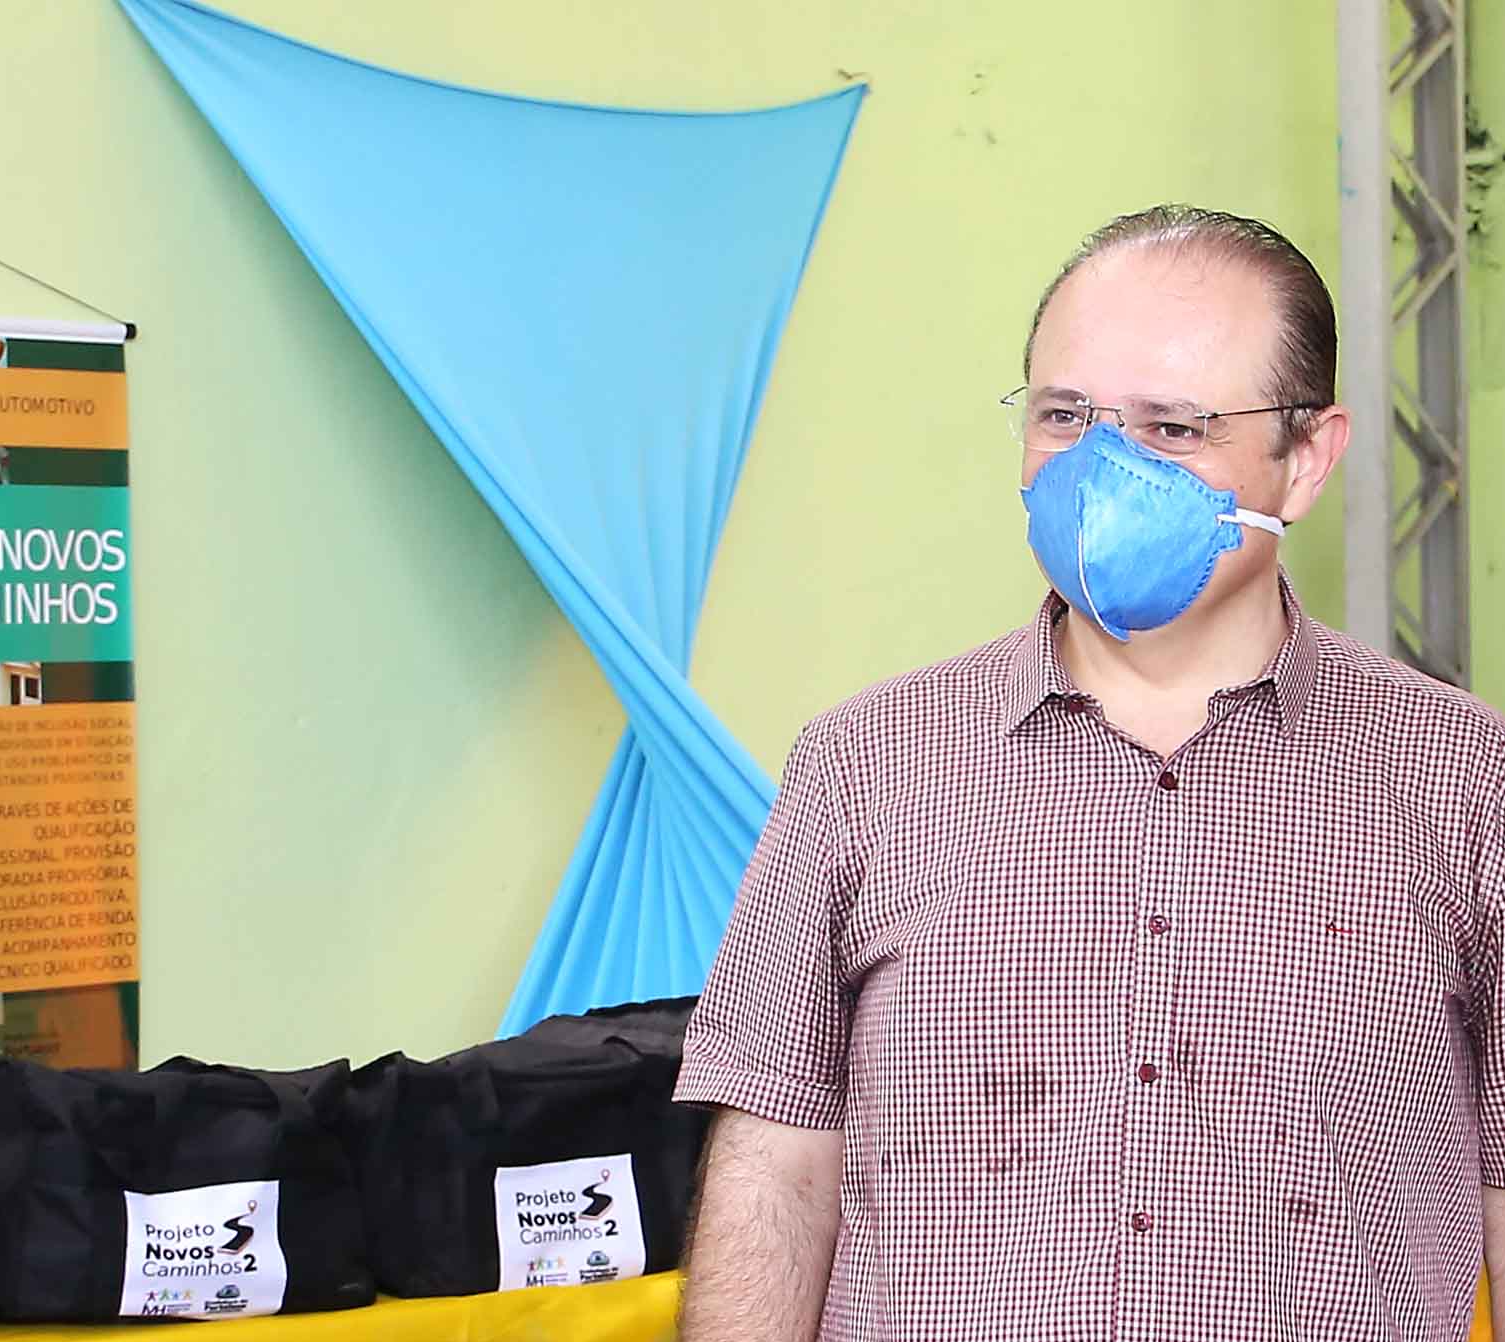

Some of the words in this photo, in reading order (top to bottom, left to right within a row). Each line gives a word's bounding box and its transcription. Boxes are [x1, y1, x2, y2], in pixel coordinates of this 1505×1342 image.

[113, 797, 134, 813] DE
[516, 1189, 576, 1207] Projeto
[518, 1211, 576, 1228] Novos
[145, 1224, 215, 1243] Projeto
[520, 1225, 602, 1244] Caminhos
[604, 1219, 619, 1237] 2
[145, 1243, 214, 1261] Novos
[143, 1259, 242, 1277] Caminhos
[243, 1254, 257, 1272] 2
